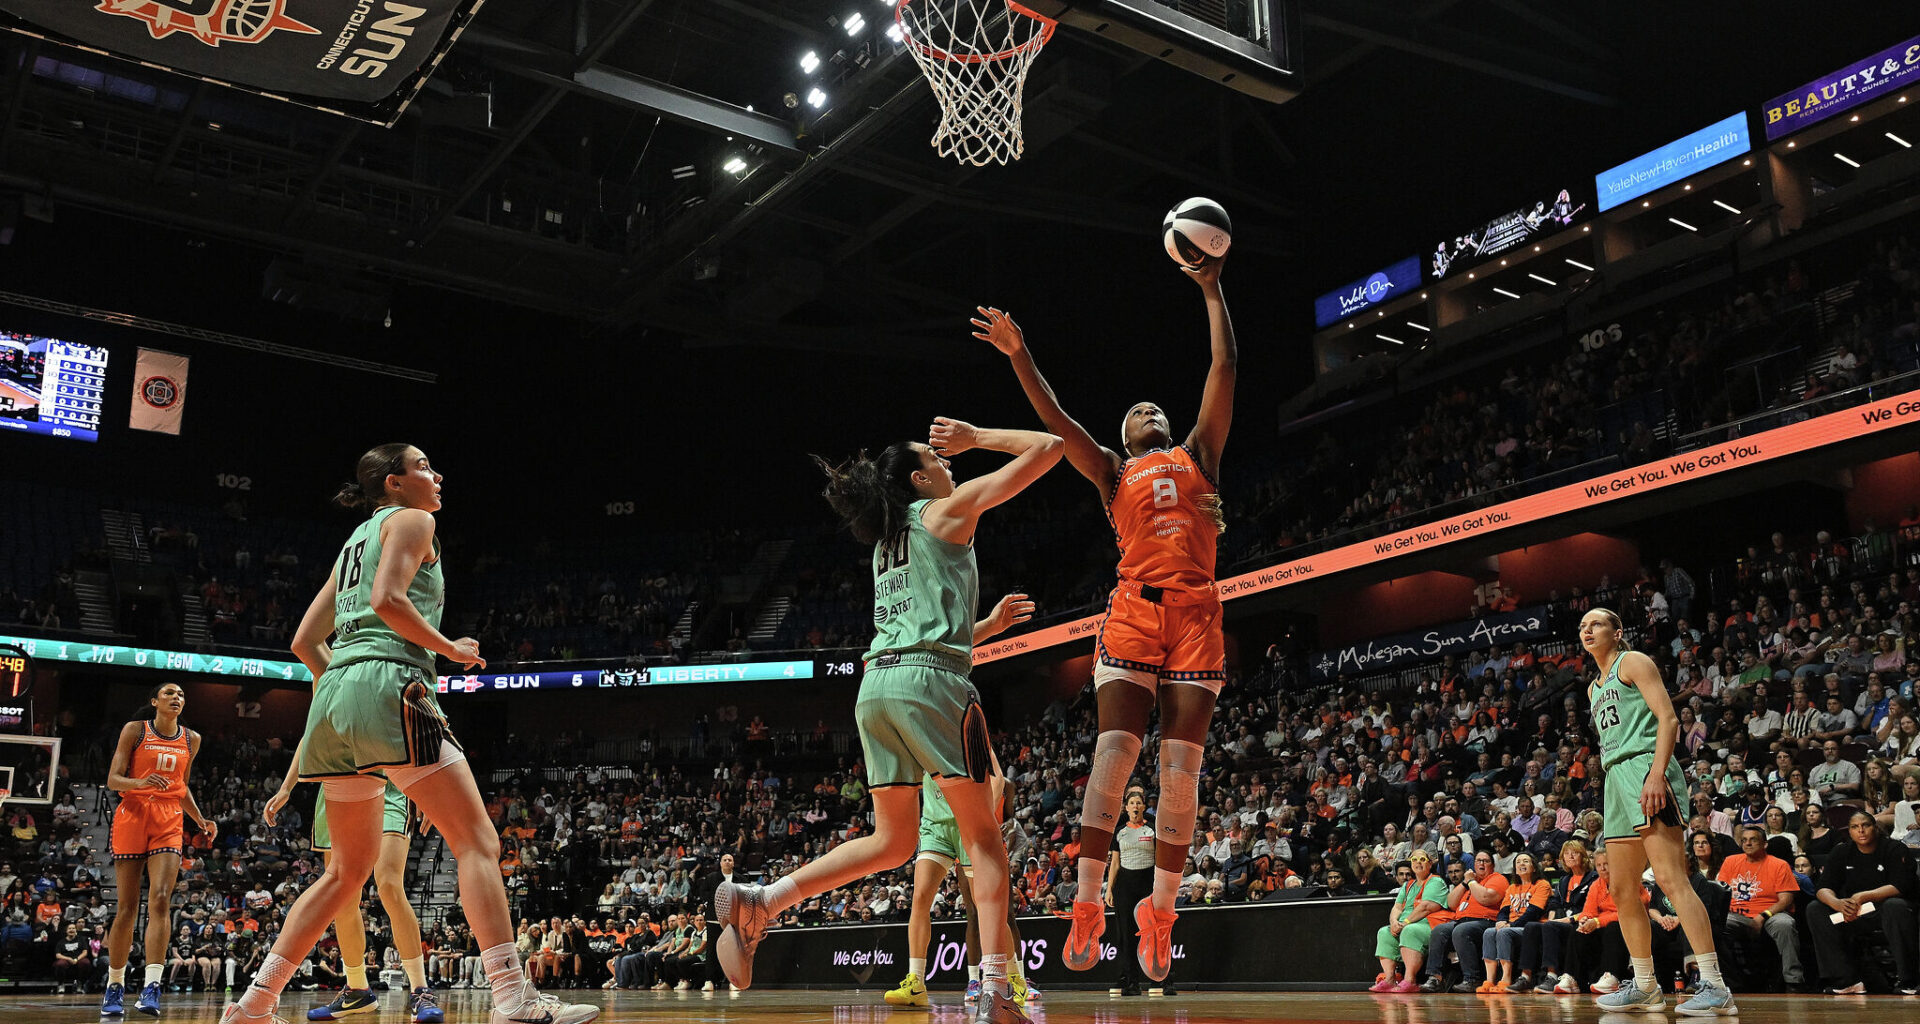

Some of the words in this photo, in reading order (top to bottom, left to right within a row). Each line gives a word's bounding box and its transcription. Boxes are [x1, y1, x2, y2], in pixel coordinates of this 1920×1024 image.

[339, 1, 427, 79] SUN
[1767, 66, 1876, 124] BEAUTY
[1800, 93, 1850, 118] RESTAURANT
[1856, 77, 1890, 95] LOUNGE
[1339, 286, 1368, 308] Wolf
[1370, 281, 1395, 296] Den
[1579, 323, 1623, 353] 106
[1862, 408, 1892, 425] We
[216, 472, 252, 490] 102
[1126, 464, 1193, 486] CONNECTICUT
[1584, 484, 1608, 498] We
[1610, 475, 1635, 491] Get
[1638, 470, 1668, 485] You.
[1670, 460, 1696, 476] We
[1699, 452, 1726, 468] Got
[1729, 444, 1762, 460] You.
[1152, 478, 1179, 509] 8
[606, 501, 635, 516] 103
[1156, 525, 1182, 537] Health
[1374, 543, 1392, 555] We
[1394, 535, 1414, 551] Get
[1415, 531, 1439, 544] You.
[1441, 523, 1461, 537] We
[1463, 516, 1483, 531] Got
[1486, 511, 1512, 525] You.
[337, 536, 369, 593] 18
[874, 572, 911, 600] STEWART
[1221, 584, 1237, 595] Get
[1238, 579, 1257, 590] You.
[1258, 574, 1274, 586] We
[1275, 568, 1293, 581] Got
[1294, 564, 1315, 576] You.
[1474, 582, 1502, 606] 15
[889, 597, 913, 617] AT&T
[1068, 626, 1081, 637] We
[1082, 622, 1095, 633] Get
[57, 644, 69, 658] 1
[91, 645, 115, 663] T/O
[990, 647, 1001, 657] We
[1002, 643, 1015, 654] Got
[1337, 641, 1419, 672] Mohegan
[1422, 631, 1466, 656] Sun
[1468, 617, 1541, 646] Arena
[0, 656, 25, 673] :48
[167, 651, 193, 670] FGM
[212, 658, 224, 672] 2
[241, 659, 264, 676] FGA
[281, 664, 293, 679] 4
[656, 666, 749, 683] LIBERTY
[783, 664, 796, 677] 4
[825, 662, 855, 676] 7:48
[494, 675, 541, 689] SUN
[572, 673, 584, 687] 5
[235, 702, 261, 718] 12
[1599, 705, 1620, 731] 23
[144, 745, 187, 755] CONNECTICUT
[156, 753, 177, 772] 10
[833, 950, 851, 966] We
[851, 949, 872, 966] Get
[873, 949, 894, 966] You.
